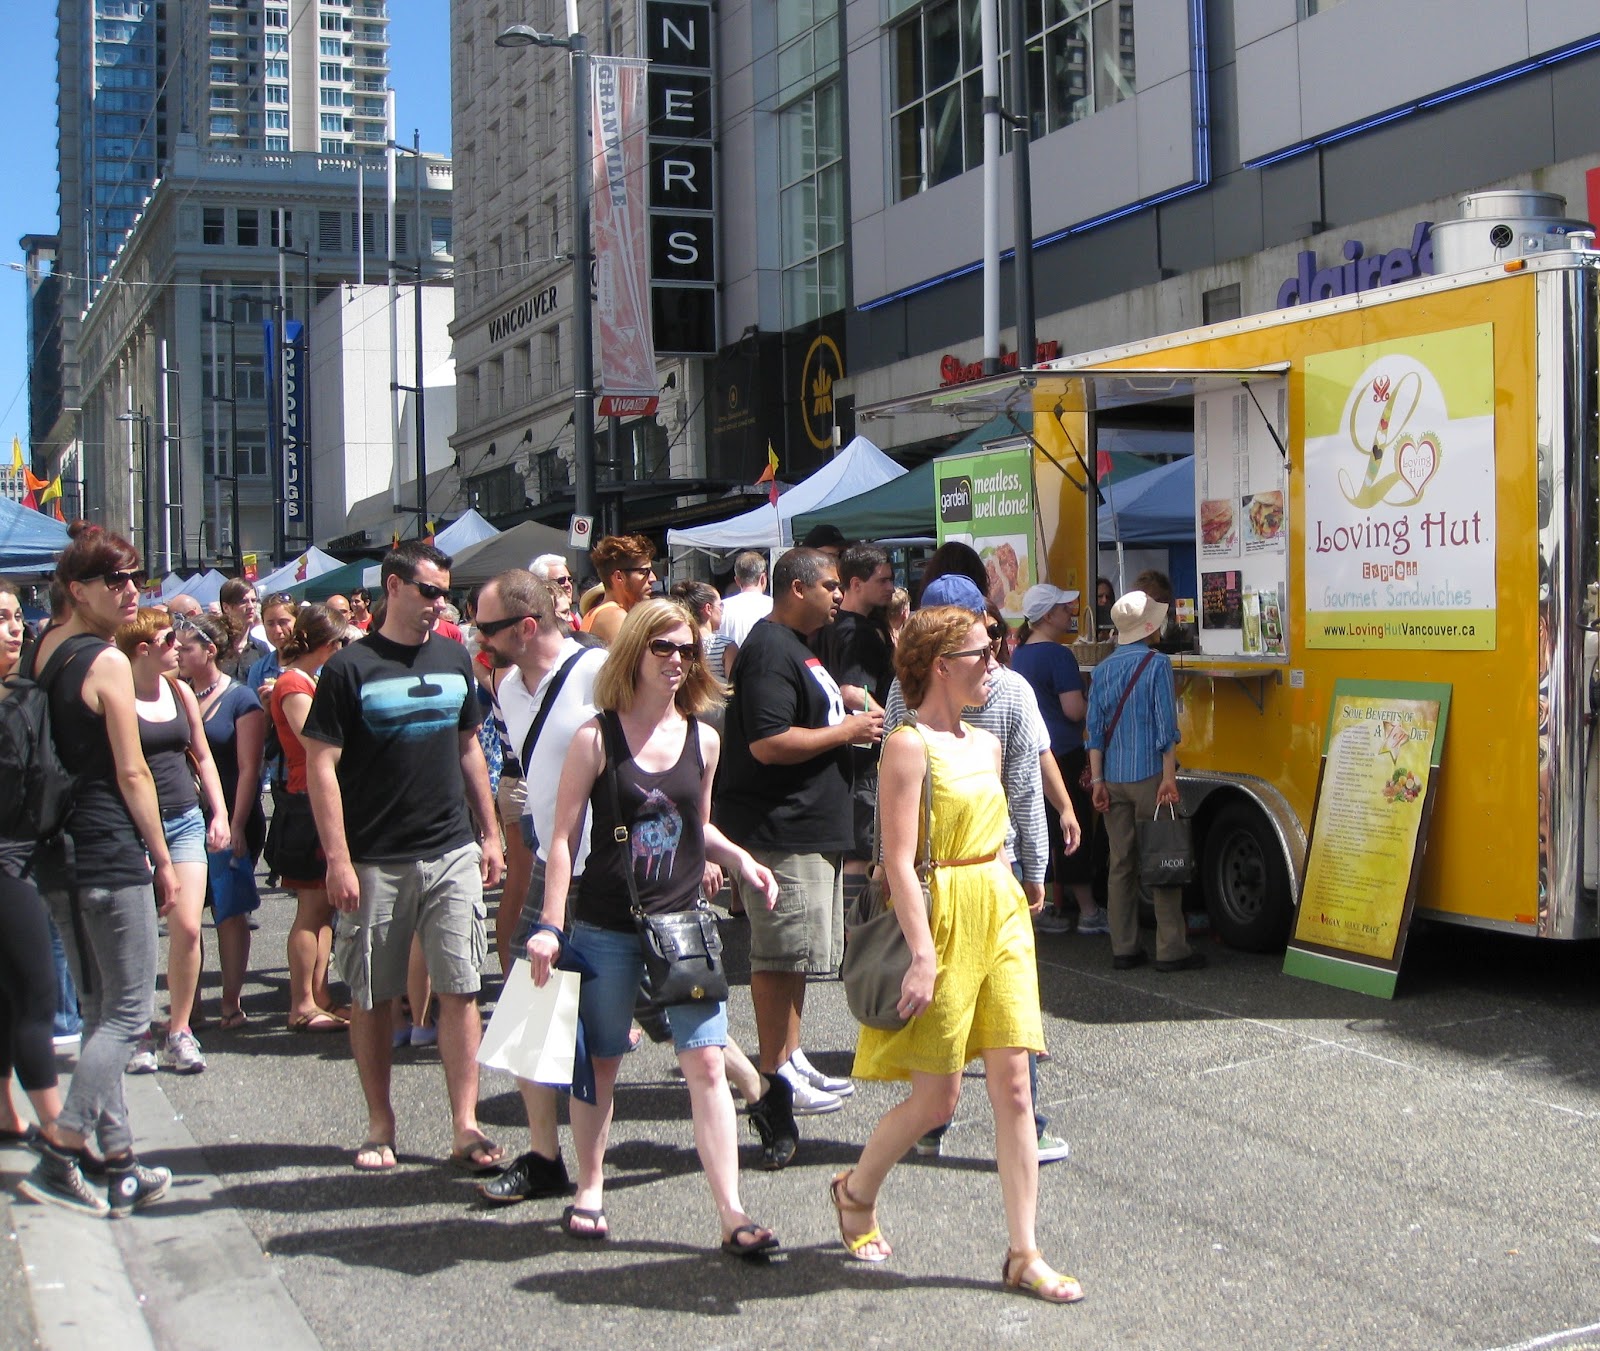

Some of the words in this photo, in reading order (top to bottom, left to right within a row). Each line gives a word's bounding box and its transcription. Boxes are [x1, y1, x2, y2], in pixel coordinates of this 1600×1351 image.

[598, 65, 627, 206] GRANVILLE
[488, 285, 558, 344] VANCOUVER
[1403, 455, 1432, 468] Loving
[1409, 467, 1425, 479] Hut
[974, 468, 1023, 495] meatless,
[941, 486, 970, 514] gardein
[974, 494, 996, 519] well
[998, 492, 1029, 517] done!
[1316, 515, 1411, 556] Loving
[1420, 510, 1482, 548] Hut
[1363, 561, 1418, 582] Express
[1323, 586, 1378, 608] Gourmet
[1385, 579, 1472, 607] Sandwiches
[1323, 622, 1476, 639] www.LovingHutVancouver.ca
[1373, 724, 1382, 738] A
[1161, 859, 1185, 868] JACOB
